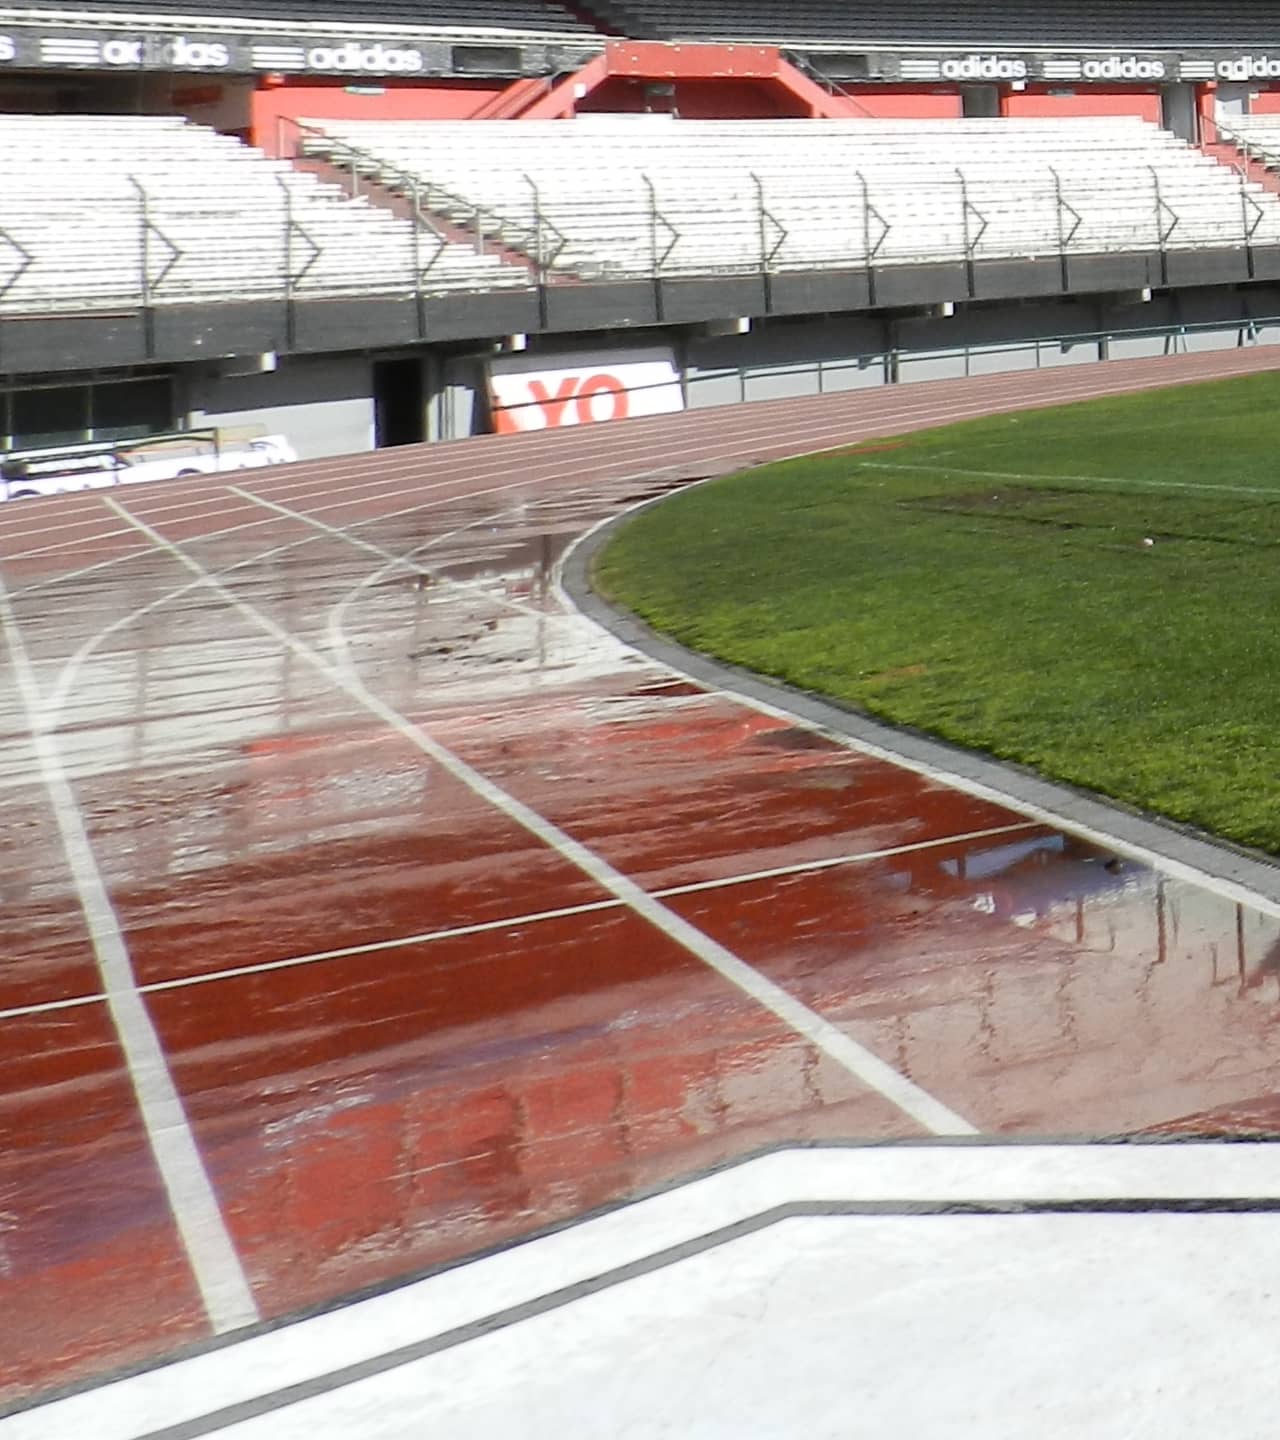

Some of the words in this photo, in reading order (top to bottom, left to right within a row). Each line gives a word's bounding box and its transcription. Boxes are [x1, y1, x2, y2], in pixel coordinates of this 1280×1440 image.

[308, 43, 422, 72] adidas
[942, 56, 1027, 78] adidas
[1083, 57, 1165, 78] adidas
